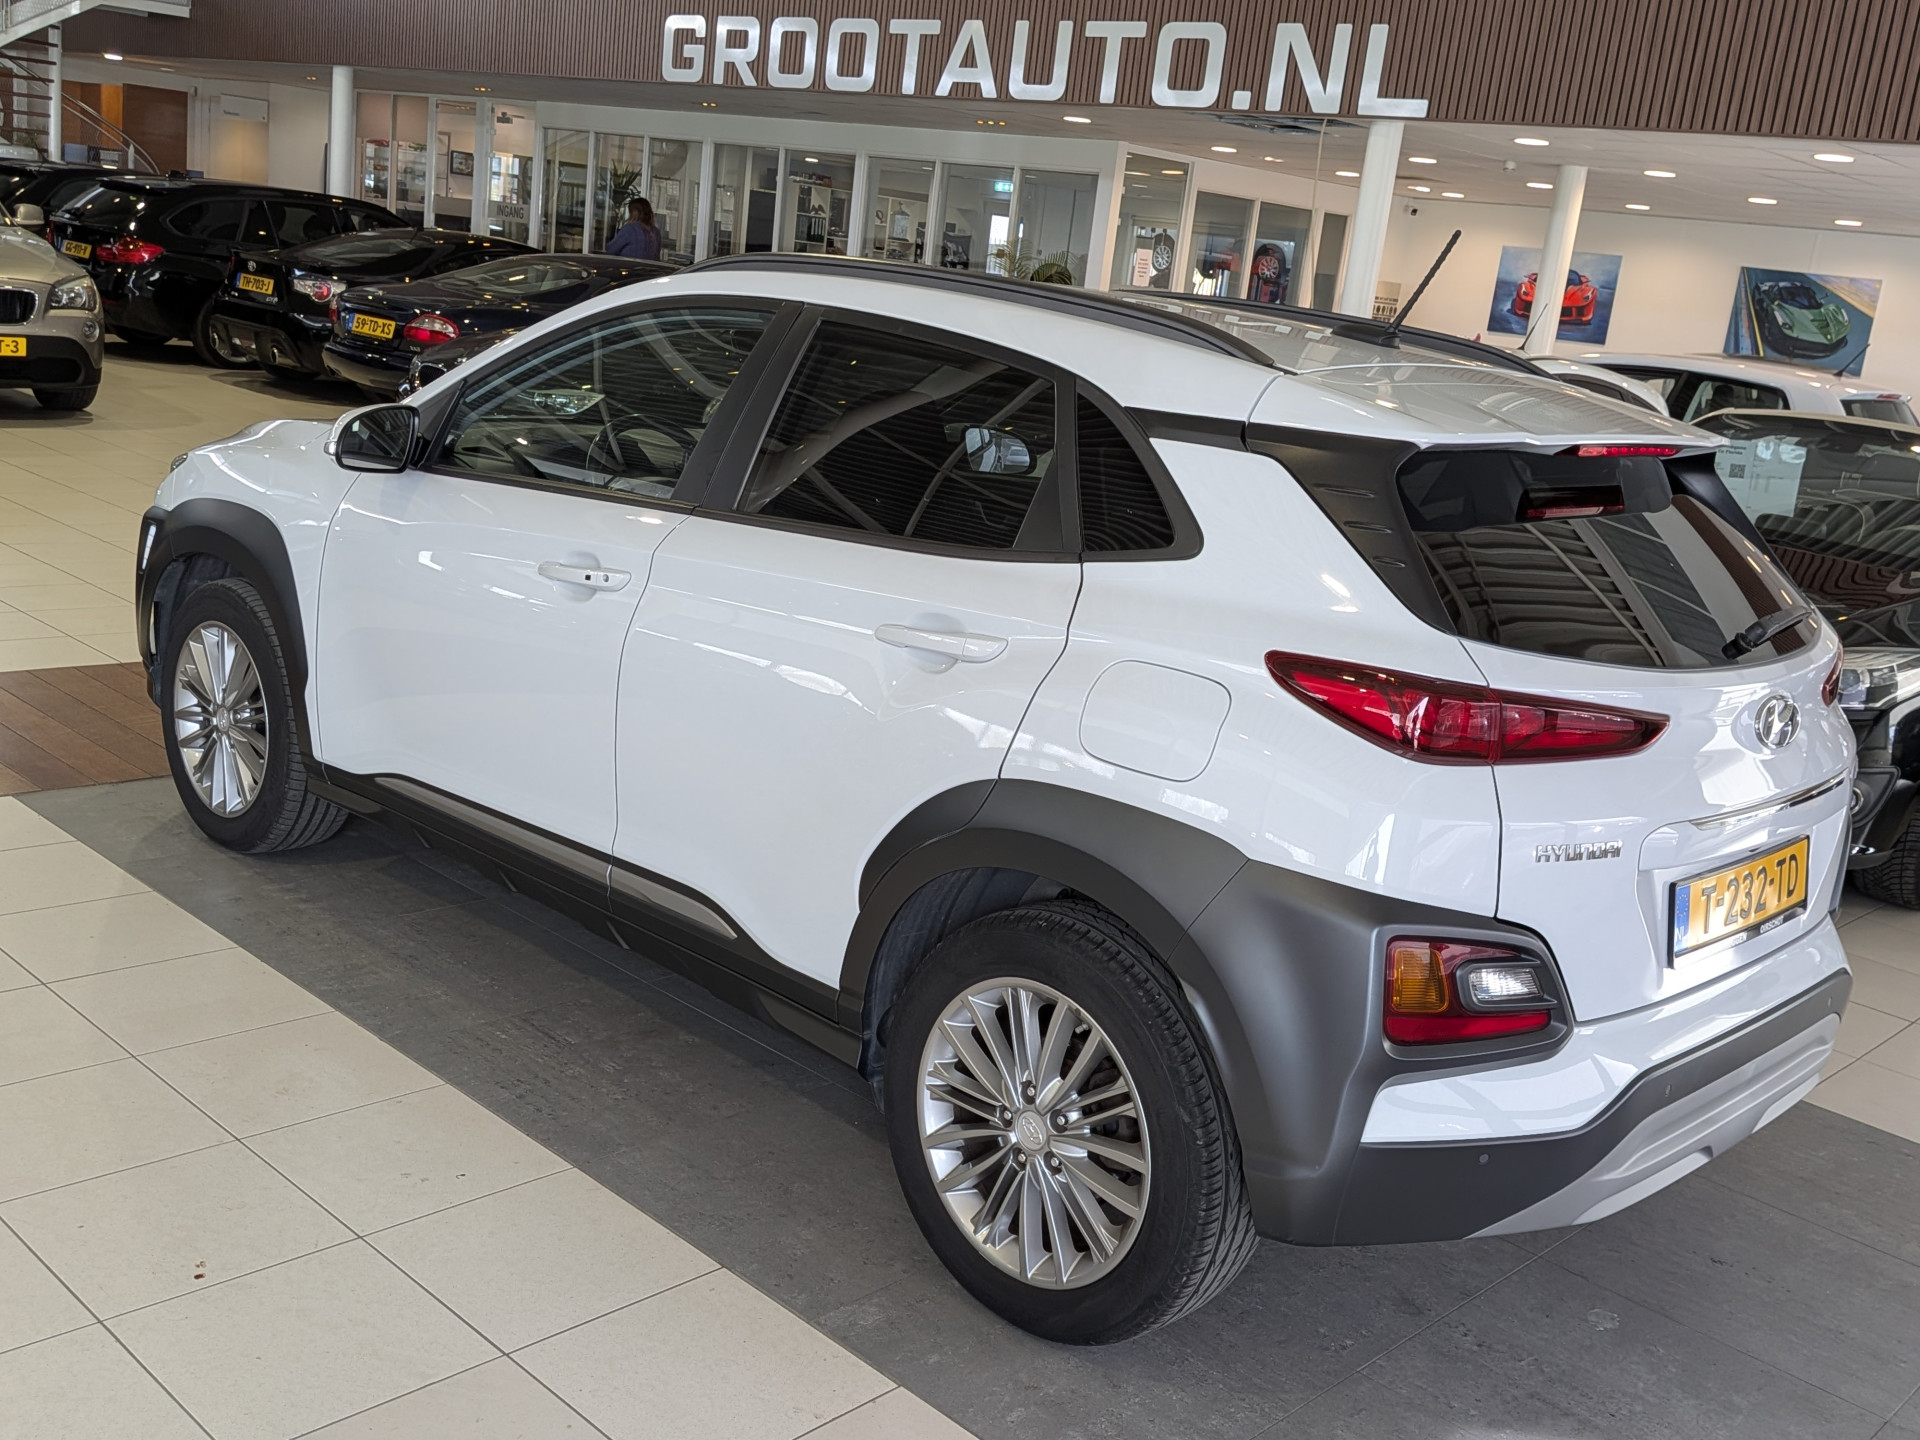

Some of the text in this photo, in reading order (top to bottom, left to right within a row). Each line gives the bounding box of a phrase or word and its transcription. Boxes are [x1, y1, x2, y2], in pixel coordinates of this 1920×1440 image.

[661, 14, 1430, 119] GROOTAUTO.NL
[496, 203, 525, 220] INGANG
[242, 275, 271, 292] TH-703-J
[354, 316, 393, 336] 59-TD-XS
[1534, 841, 1623, 863] HYUNDAI
[1702, 853, 1799, 934] T-232-TD
